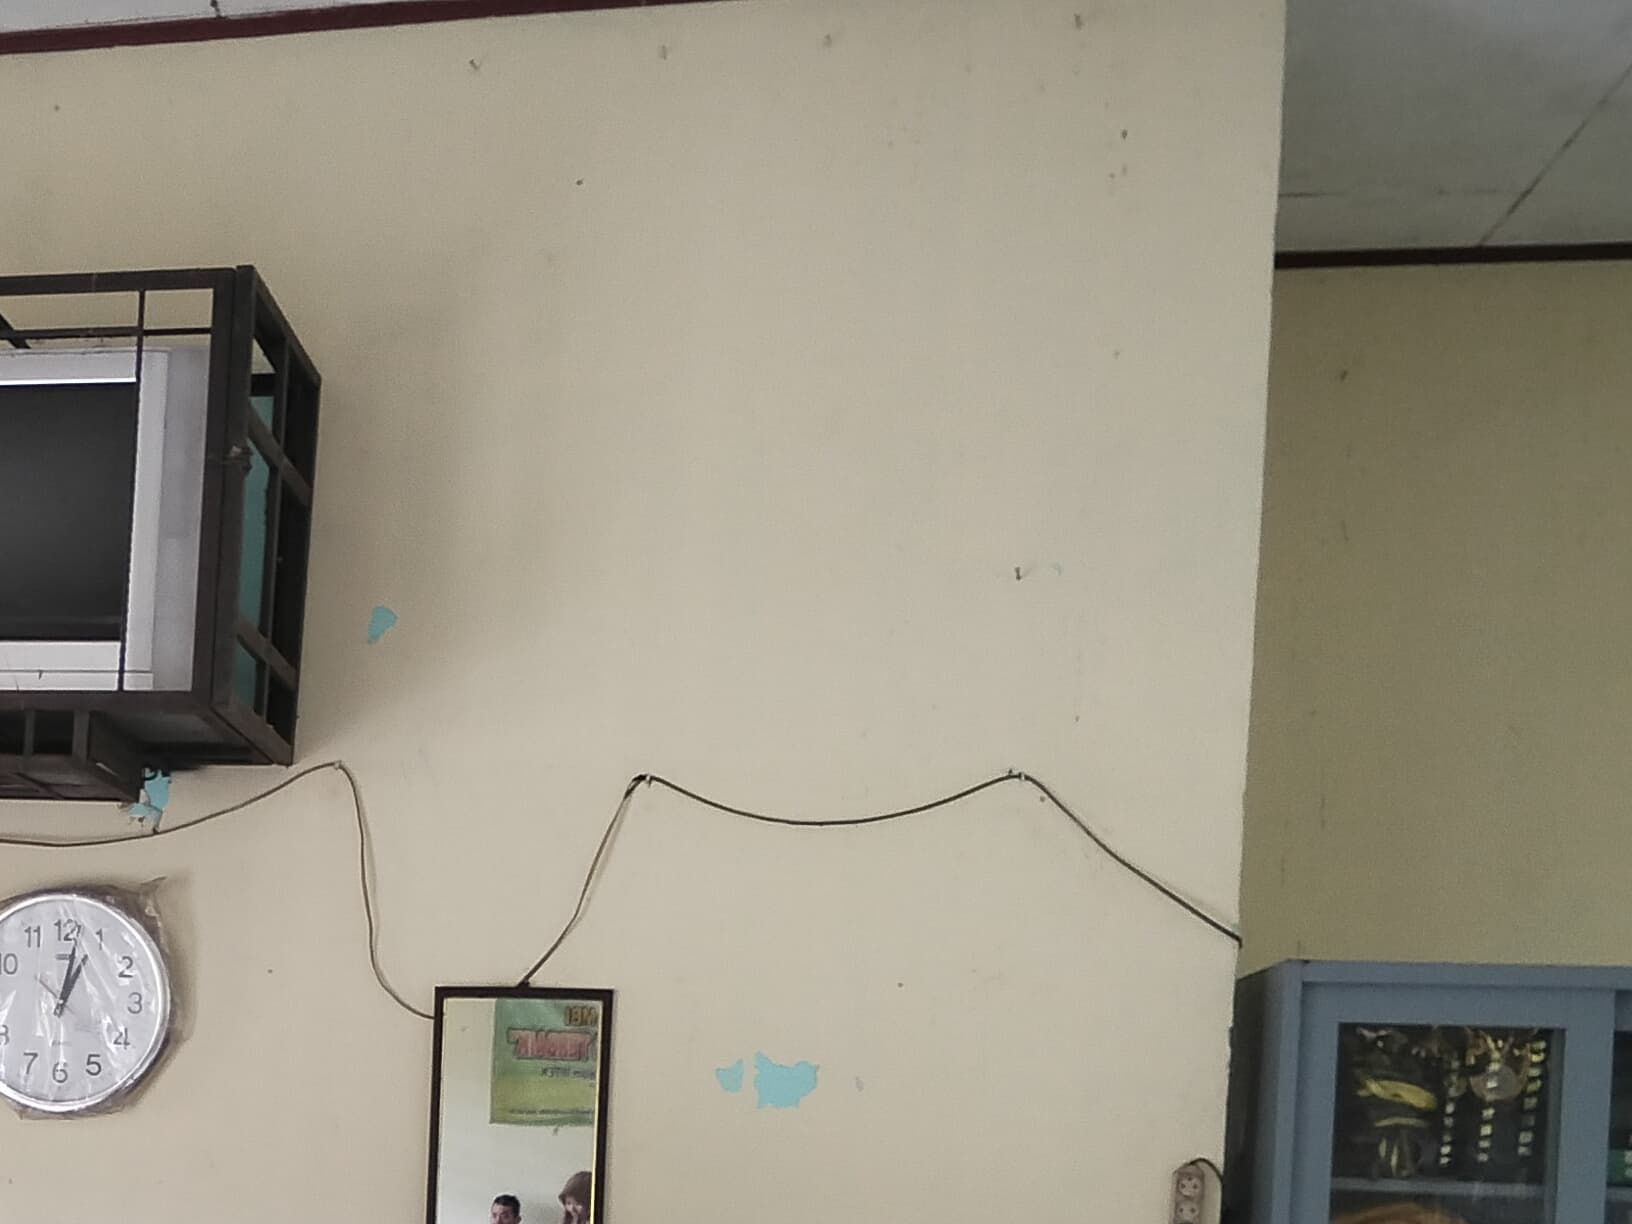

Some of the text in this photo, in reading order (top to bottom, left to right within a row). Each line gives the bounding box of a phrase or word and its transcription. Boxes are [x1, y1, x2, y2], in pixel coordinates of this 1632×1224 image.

[24, 926, 41, 948] 11
[54, 919, 77, 941] 12
[95, 928, 104, 950] 1
[119, 956, 134, 978] 2
[127, 992, 143, 1014] 3
[113, 1028, 130, 1050] 4
[23, 1052, 39, 1075] 7
[52, 1062, 68, 1083] 6
[86, 1054, 102, 1076] 5
